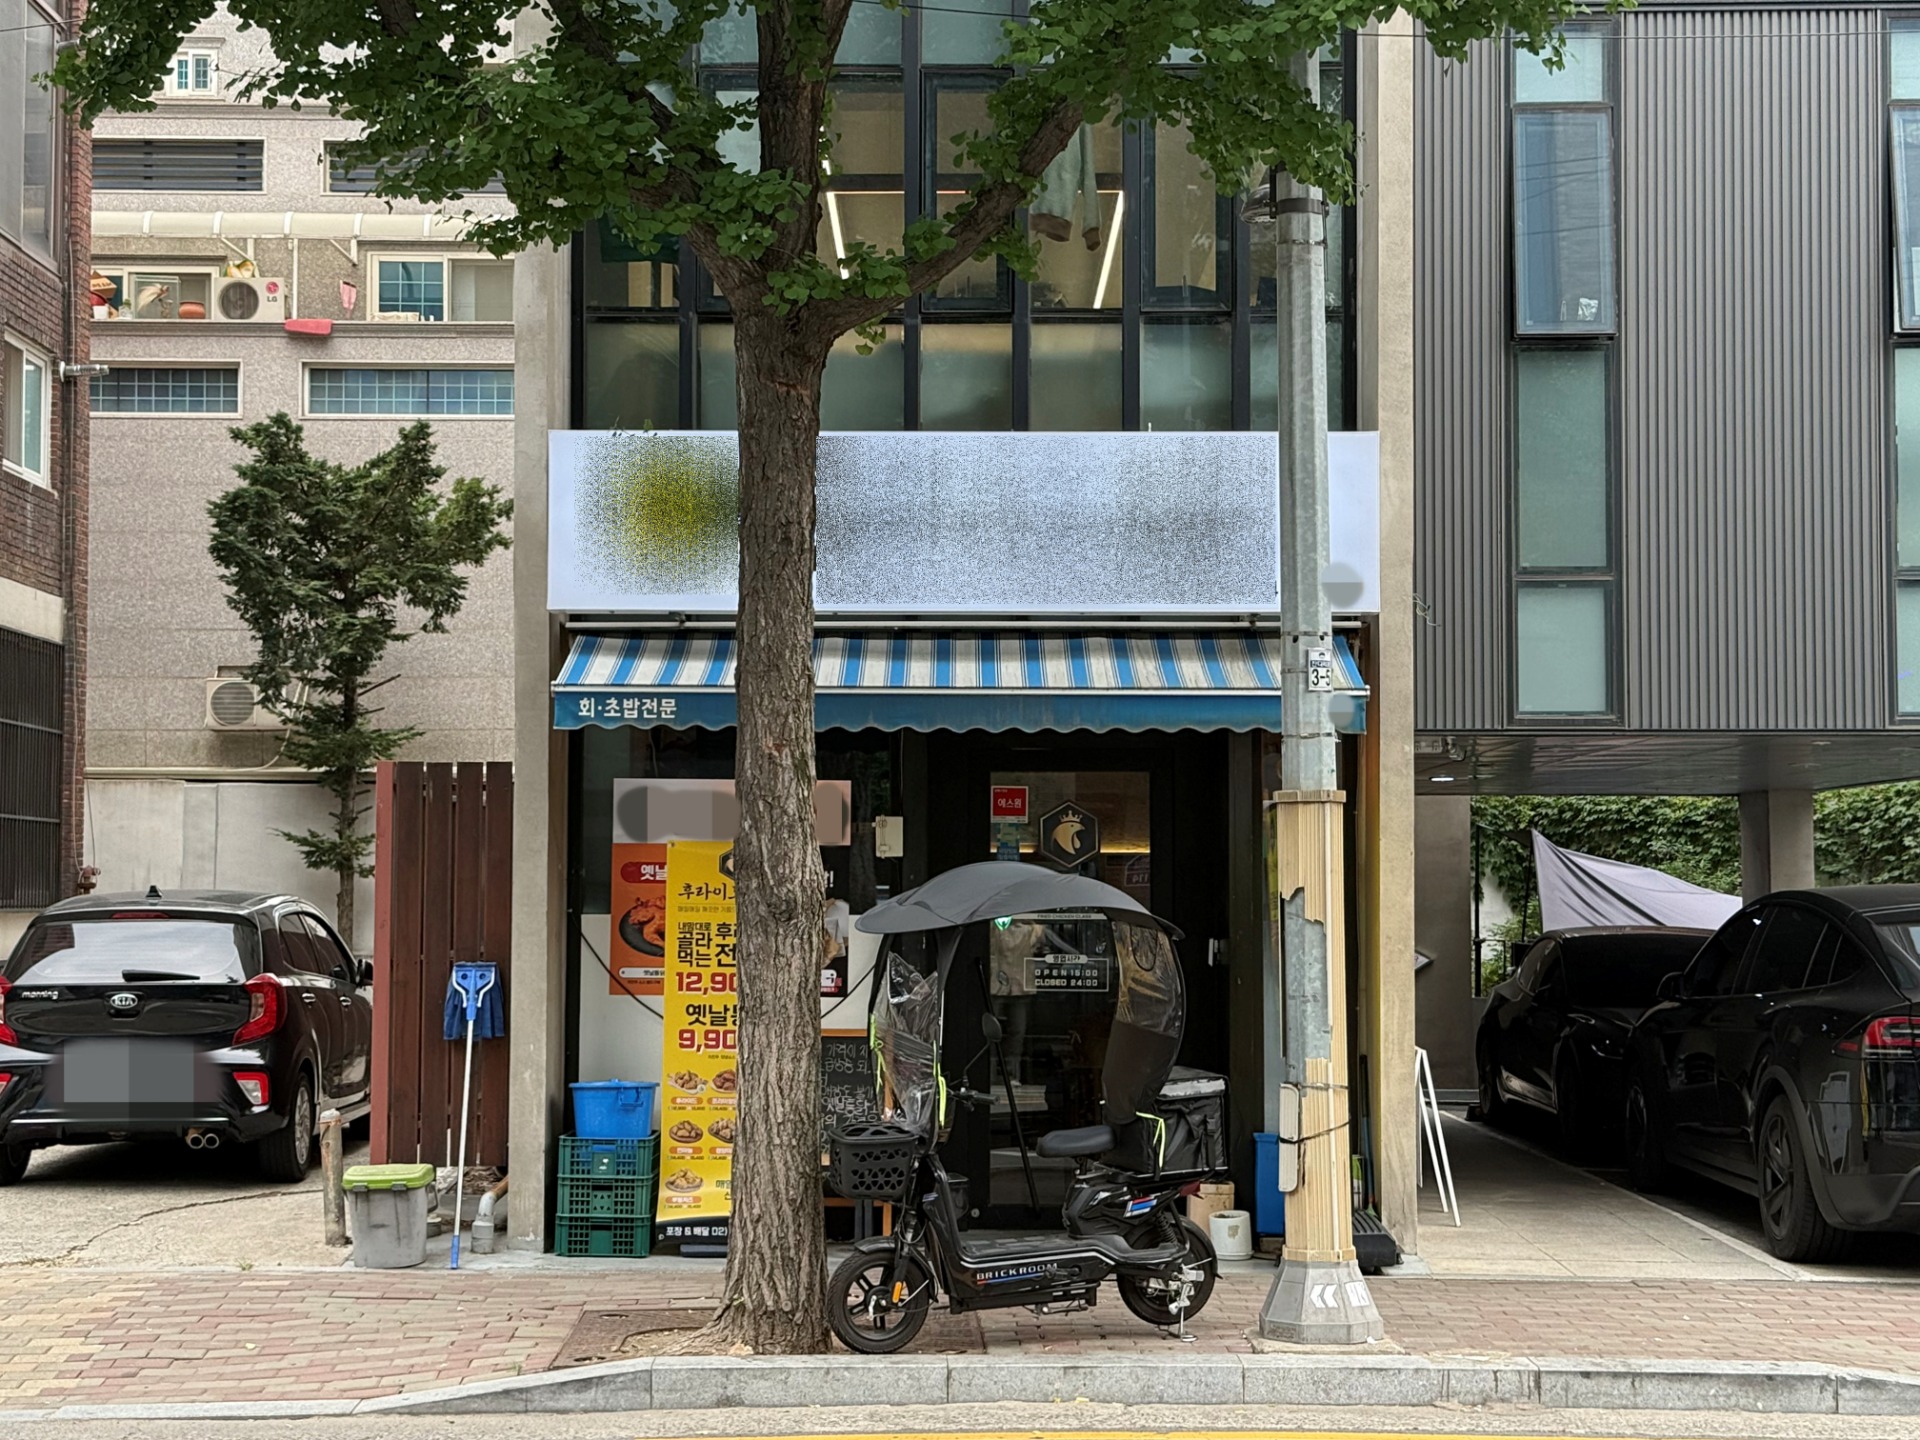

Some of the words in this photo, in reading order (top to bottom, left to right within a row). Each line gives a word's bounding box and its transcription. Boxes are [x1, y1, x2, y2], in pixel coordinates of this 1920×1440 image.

[266, 295, 278, 303] LG
[1311, 668, 1331, 687] 3-5
[997, 797, 1022, 809] 에스원
[677, 931, 712, 950] 골라
[677, 949, 712, 968] 먹는
[1034, 969, 1068, 977] OPEN
[1034, 979, 1067, 987] CLOSED
[1070, 979, 1099, 987] 24:00
[21, 990, 59, 999] morning
[113, 997, 134, 1005] KIA
[977, 1263, 1058, 1280] BRICKROOM
